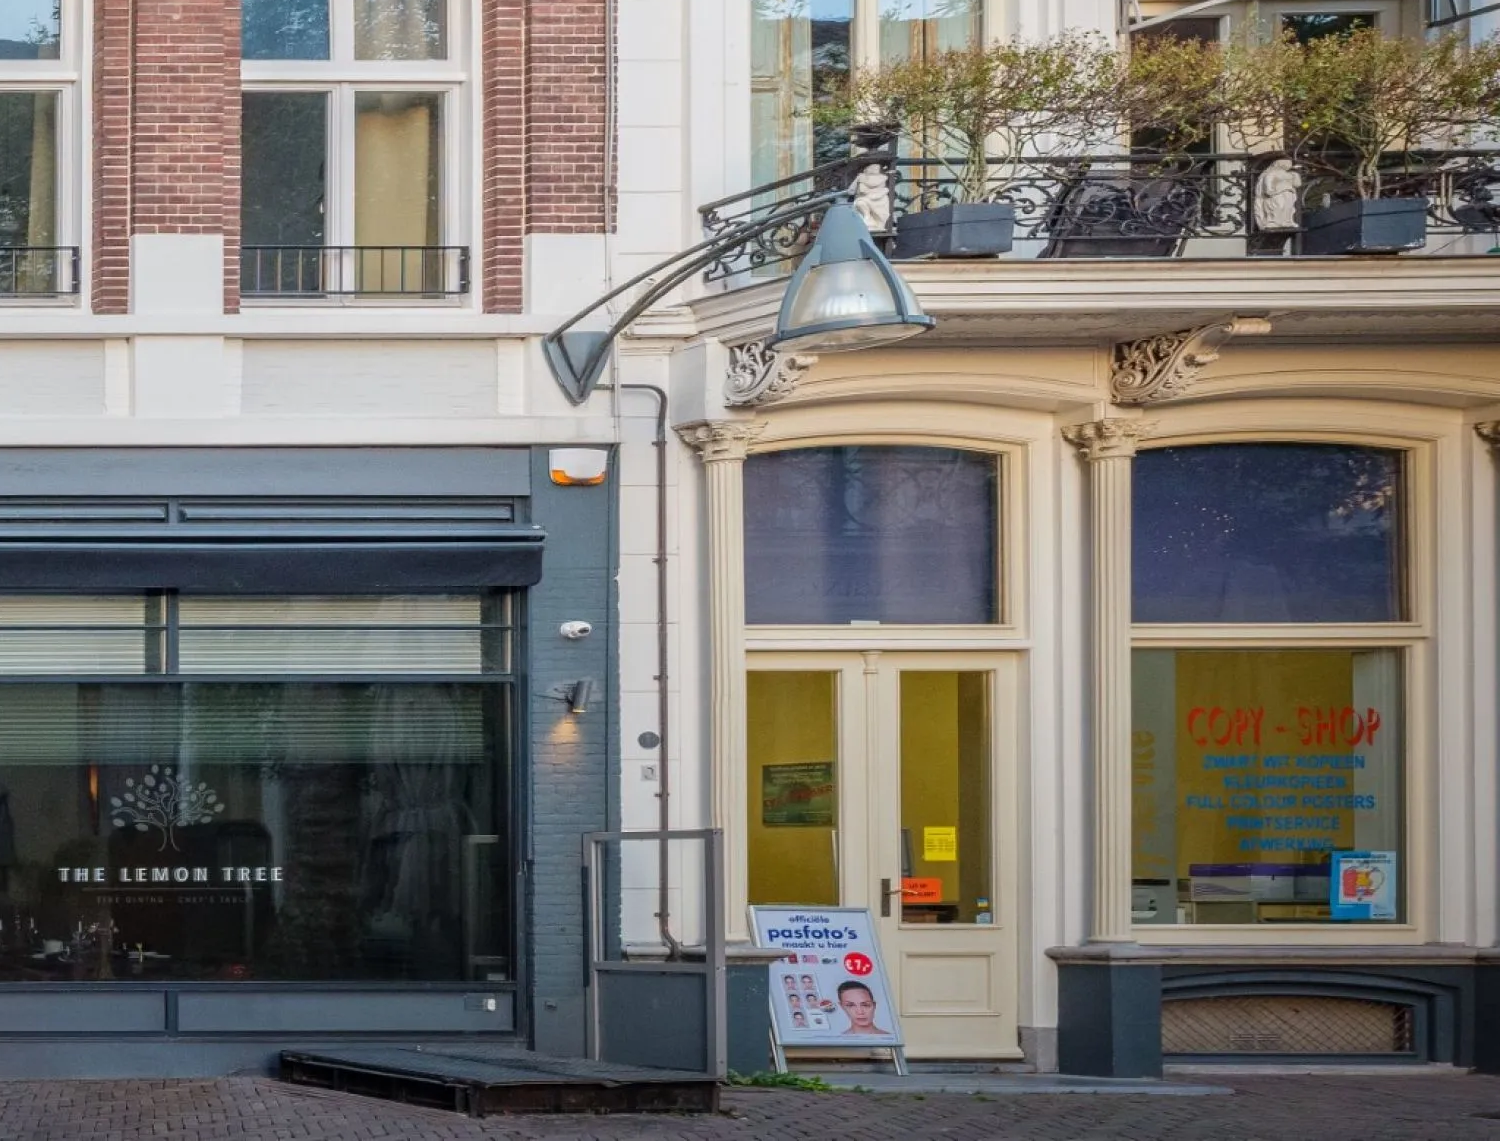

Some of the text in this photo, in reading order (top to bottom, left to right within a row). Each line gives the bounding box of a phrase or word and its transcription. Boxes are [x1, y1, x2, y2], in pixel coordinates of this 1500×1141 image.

[1187, 706, 1265, 747] COPY
[1297, 706, 1381, 747] SHOP
[1186, 795, 1376, 809] FULL COLOUR POSTERS
[1227, 815, 1340, 830] PRINTSERVICE
[58, 867, 283, 882] THE LEMON TREE
[768, 926, 858, 942] pasfoto's
[781, 941, 816, 949] maakt
[827, 941, 848, 949] hier
